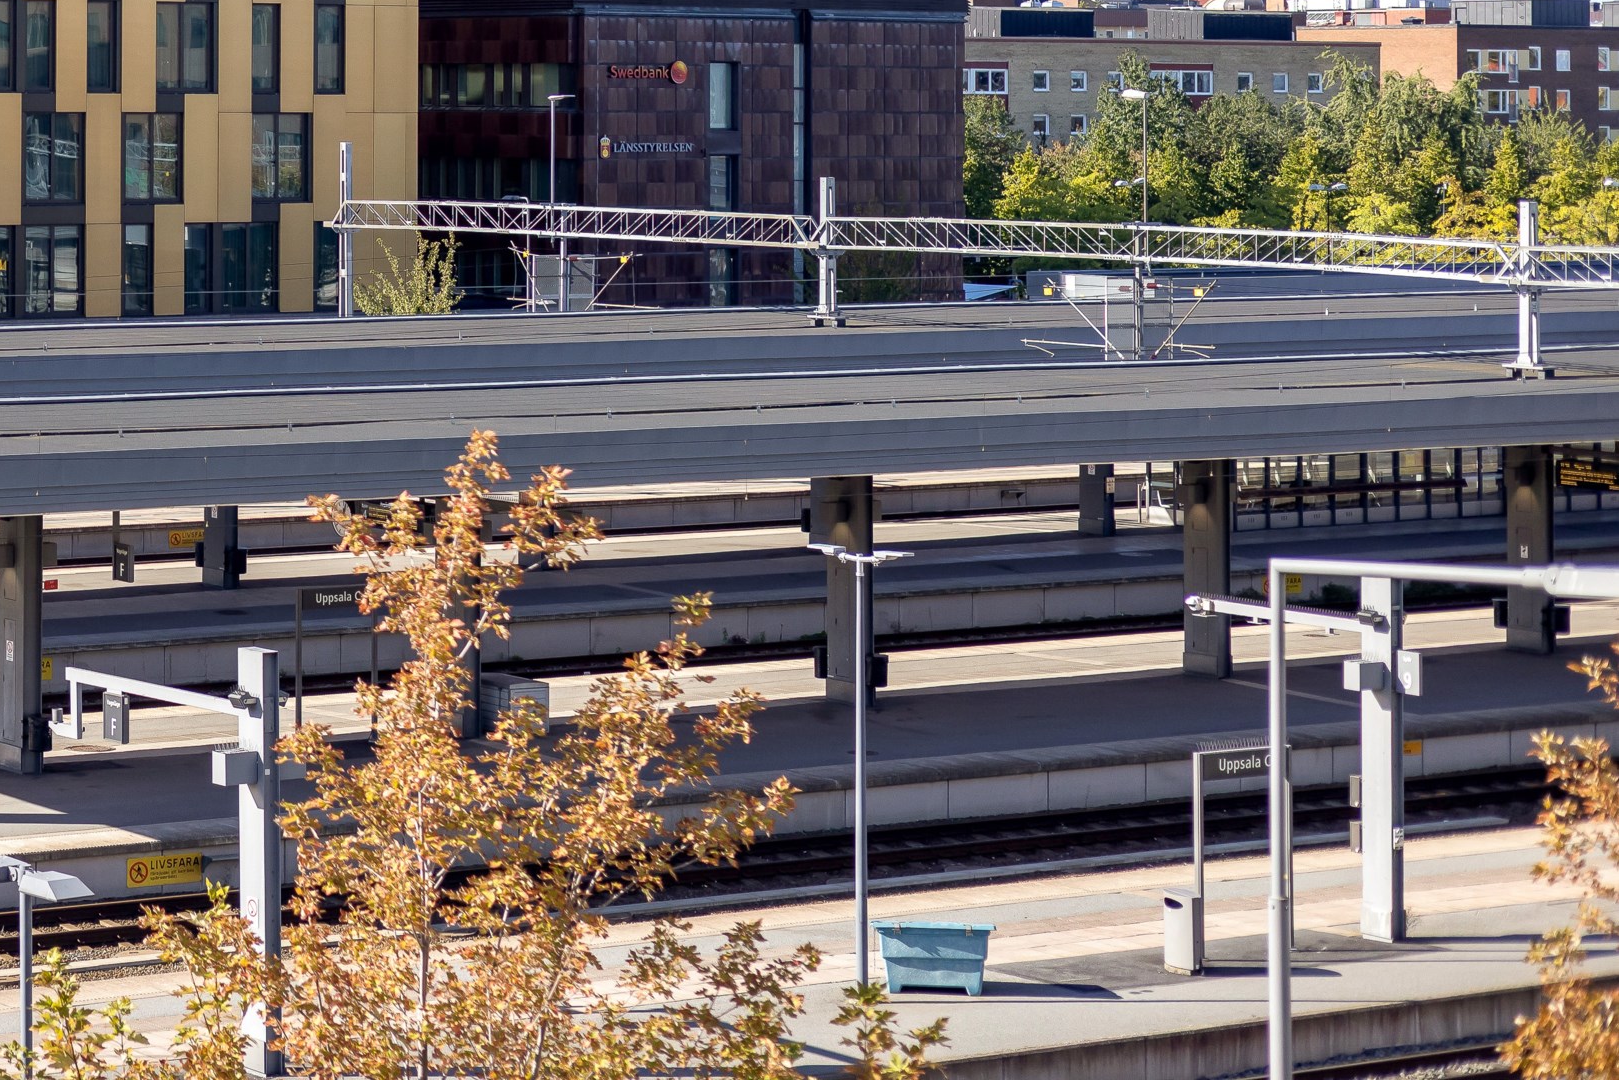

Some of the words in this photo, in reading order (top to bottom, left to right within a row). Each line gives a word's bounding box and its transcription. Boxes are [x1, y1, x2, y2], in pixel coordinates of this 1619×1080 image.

[610, 65, 670, 79] Swedbank
[613, 140, 693, 153] LÄNSSTYRELSEN
[182, 530, 204, 538] LIVSFA
[119, 562, 125, 577] F
[315, 590, 352, 606] Uppsala
[1403, 671, 1412, 690] 9
[111, 717, 117, 736] F
[1218, 754, 1261, 774] Uppsala
[1264, 754, 1272, 767] C
[150, 856, 200, 870] LIVSFARA
